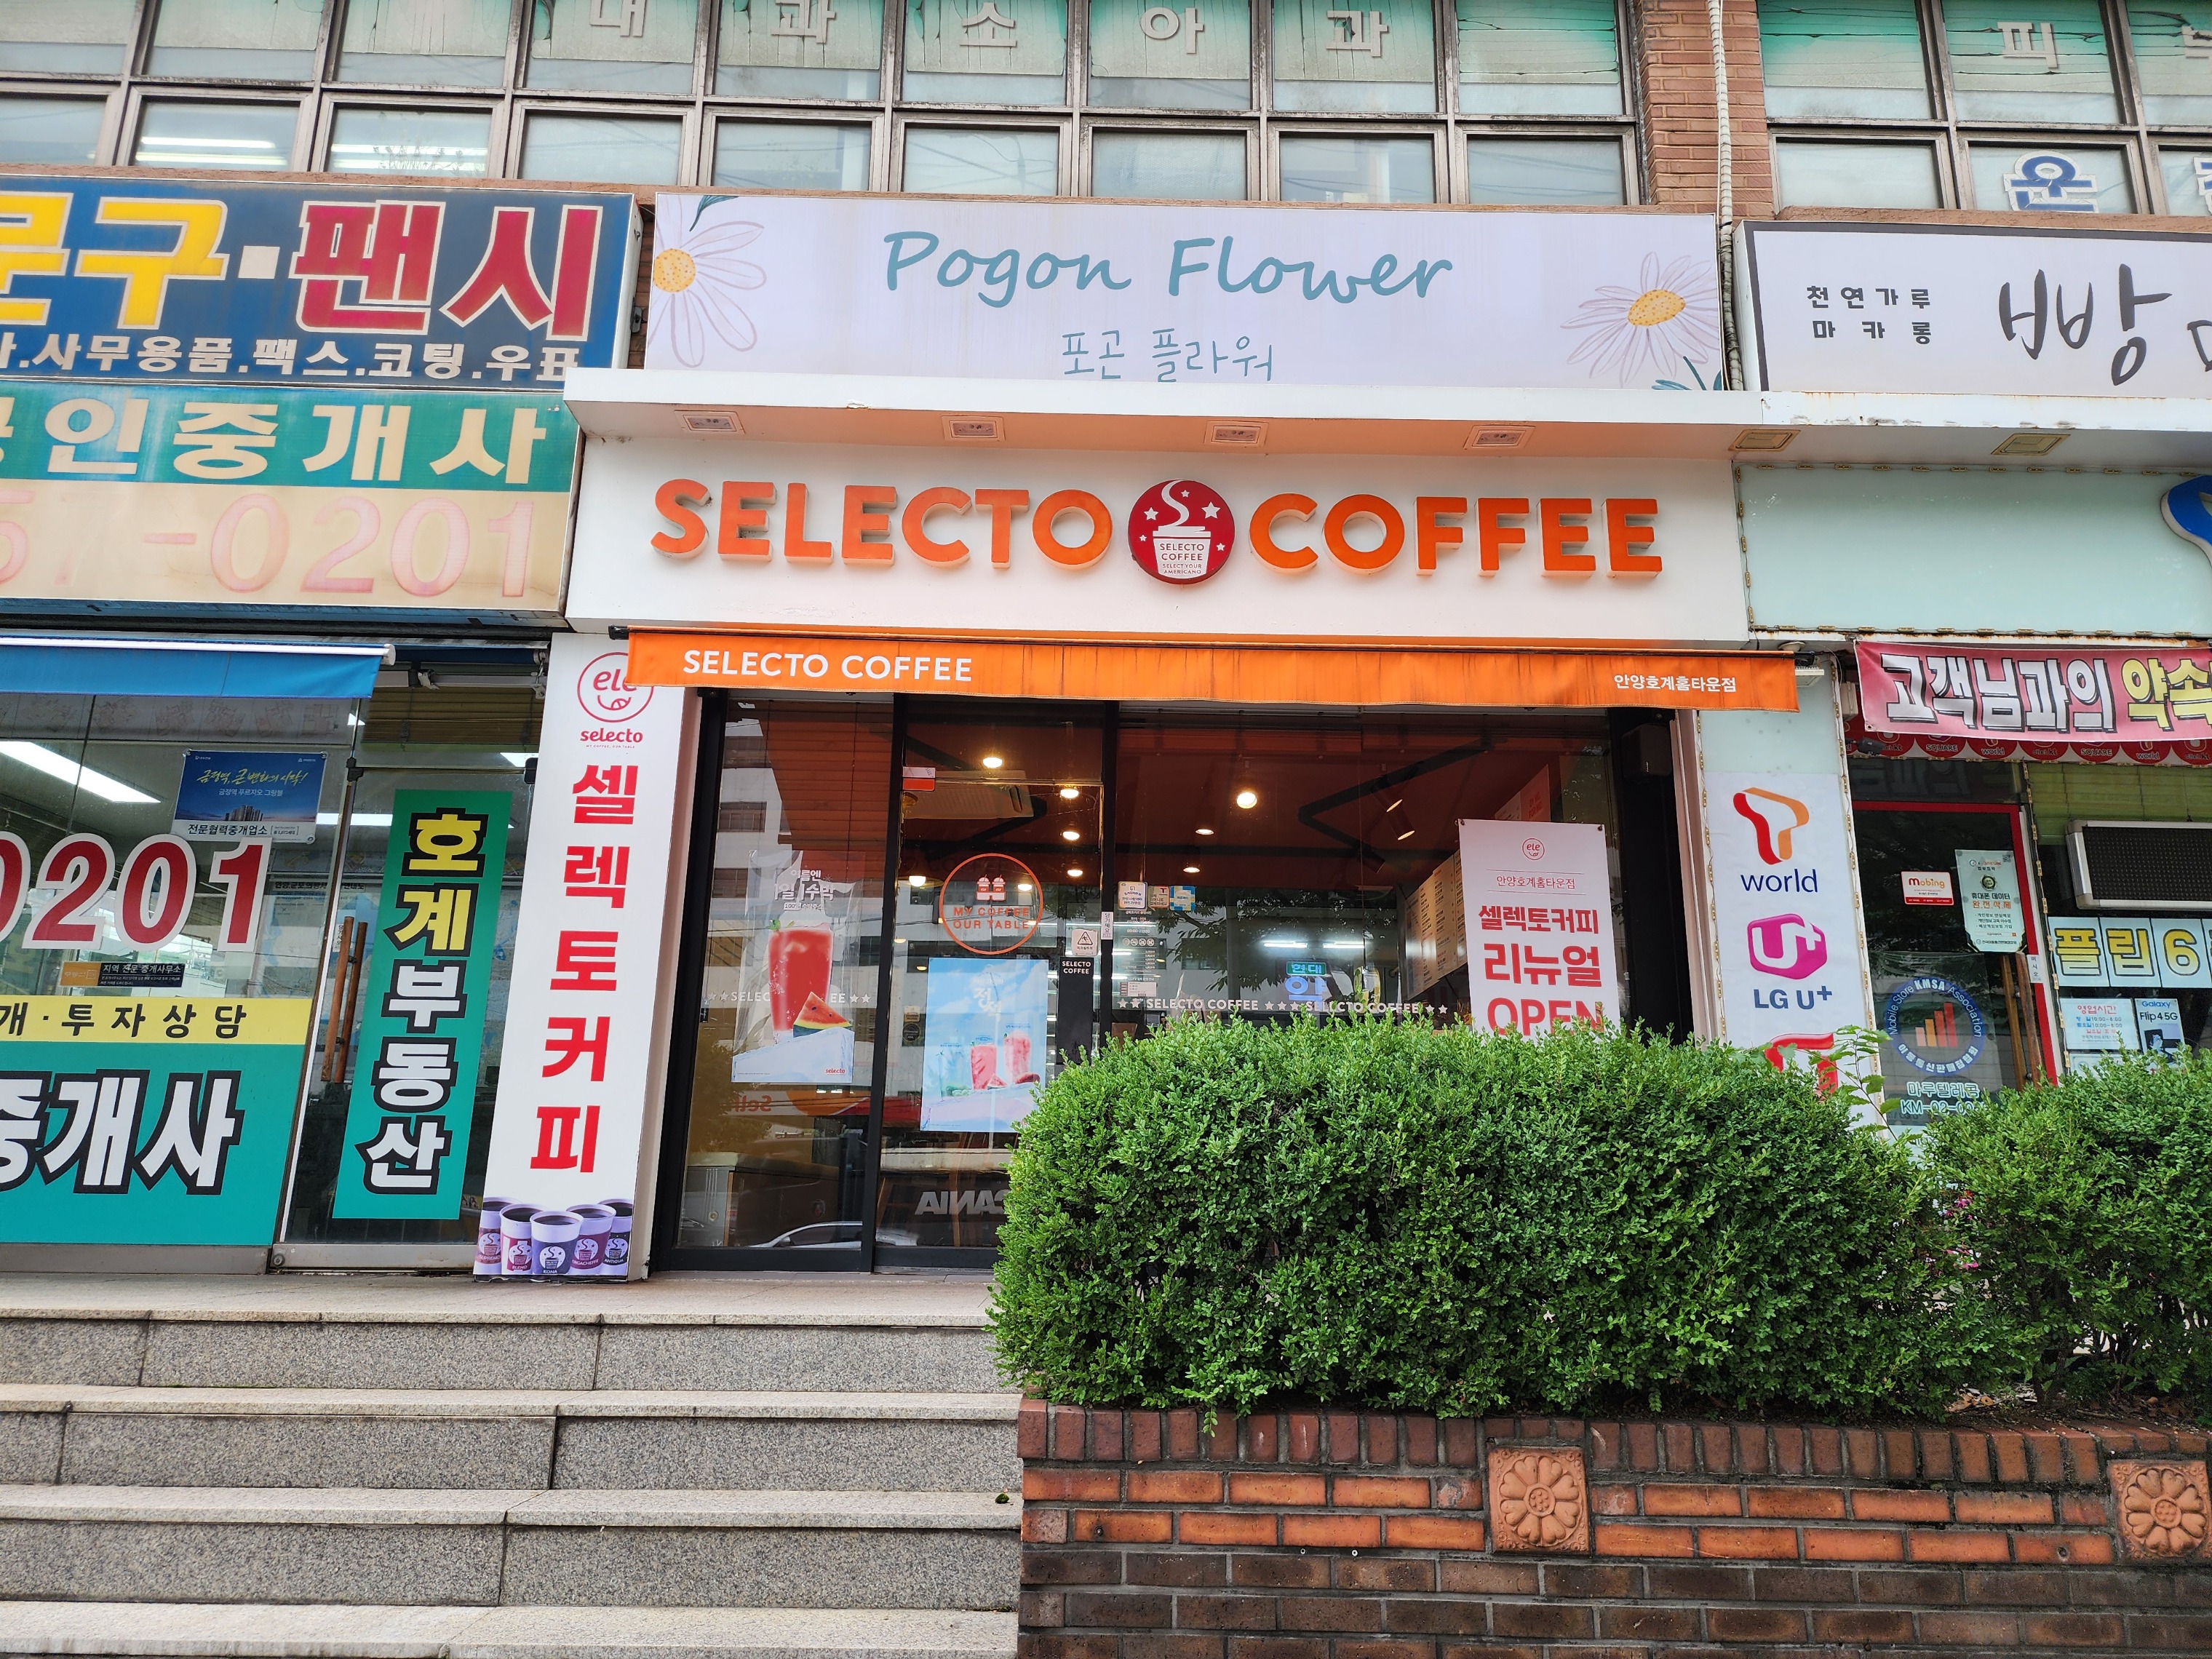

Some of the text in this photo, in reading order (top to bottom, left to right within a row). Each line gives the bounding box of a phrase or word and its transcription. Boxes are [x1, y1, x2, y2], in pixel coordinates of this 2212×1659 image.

[883, 231, 1453, 308] Pogon Flower
[1806, 285, 1931, 310] 천연가루
[1812, 320, 1932, 346] 마카롱
[1062, 327, 1274, 383] 포곤 플라워
[0, 397, 546, 484] 인중개사
[651, 477, 1662, 578] SELECTO COFFEE
[1159, 543, 1204, 552] SELECTO
[1161, 553, 1203, 561] COFFEE
[683, 649, 972, 682] SELECTO COFFEE
[1613, 674, 1737, 692] 안양호계홈타운점
[1880, 652, 2117, 733] 고객님과의
[580, 728, 643, 743] selecto
[1925, 744, 1958, 752] SQUARE
[1981, 747, 2005, 755] world
[2081, 748, 2112, 756] SQUARE
[2136, 752, 2160, 761] world
[188, 823, 268, 836] 전문협력중개업소
[1526, 843, 1541, 853] ele
[1496, 875, 1575, 890] 안양호계홈타운점
[1740, 868, 1818, 894] world
[953, 907, 1030, 917] MY COFFEE
[1478, 904, 1599, 935] 셀렉토커피
[953, 920, 1030, 929] OUR TABLE
[103, 964, 119, 973] 지역
[140, 965, 181, 974] 중개사무소
[530, 764, 639, 1174] 셀렉토커피
[1484, 944, 1602, 987] 리뉴얼
[357, 808, 487, 1193] 호계부동산
[1146, 998, 1259, 1011] SELECTO COFFEE
[1754, 985, 1833, 1009] LG U+
[2141, 1000, 2171, 1008] Galaxy
[1887, 979, 1983, 1038] Mobile Store KMSA Association
[2077, 1005, 2117, 1015] 영업시간
[2163, 1012, 2178, 1021] 5G
[1487, 997, 1604, 1038] OPEN
